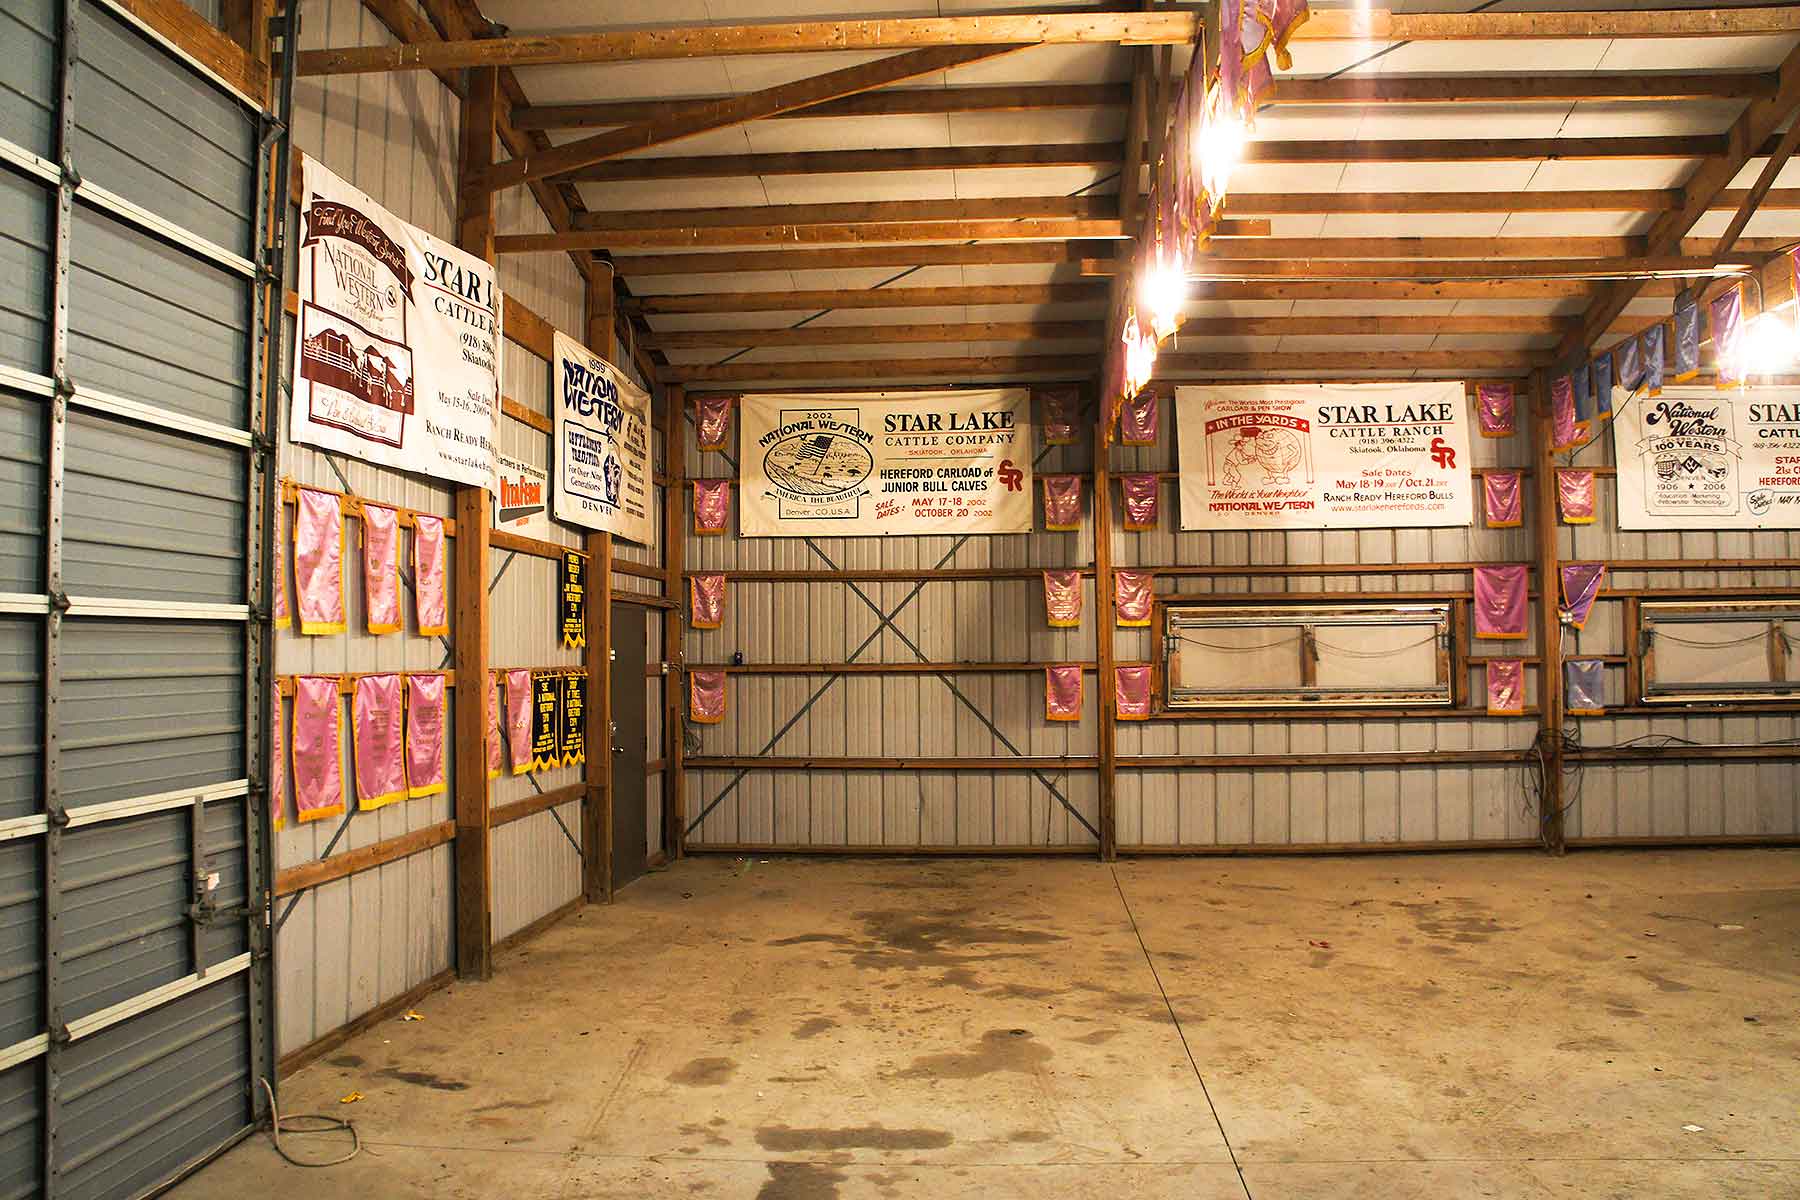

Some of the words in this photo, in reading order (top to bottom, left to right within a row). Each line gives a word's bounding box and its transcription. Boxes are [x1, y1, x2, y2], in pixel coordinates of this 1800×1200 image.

[322, 238, 378, 289] NATIONAL
[424, 251, 480, 303] STAR
[334, 269, 384, 312] WESTERN
[434, 296, 486, 331] CATTLE
[589, 358, 606, 374] 1999
[1318, 406, 1380, 424] STAR
[1385, 403, 1454, 422] LAKE
[1646, 402, 1720, 426] National
[884, 413, 943, 432] STAR
[948, 411, 1016, 431] LAKE
[1216, 419, 1230, 430] IN
[1230, 416, 1254, 426] THE
[1255, 415, 1298, 428] YARDS
[1670, 418, 1728, 436] Western
[758, 420, 815, 448] NATIONAL
[818, 420, 874, 444] WESTERN
[1330, 428, 1386, 438] CATTLE
[1393, 426, 1443, 436] RANCH
[885, 436, 938, 446] CATTLE
[946, 434, 1016, 446] COMPANY
[1655, 442, 1674, 451] 100
[1676, 440, 1720, 452] YEARS
[880, 468, 933, 480] HEREFORD
[936, 467, 982, 478] CARLOAD
[984, 467, 994, 478] of
[1775, 466, 1791, 474] 21st
[570, 476, 601, 492] Generations
[881, 481, 918, 493] JUNIOR
[922, 480, 948, 492] BULL
[951, 480, 988, 492] CALVES
[1336, 480, 1359, 490] May
[1703, 482, 1726, 490] 2006
[912, 498, 934, 506] MAY
[938, 497, 962, 506] 17-18
[1324, 492, 1352, 502] RANCH
[1354, 492, 1382, 502] READY
[1384, 492, 1428, 500] HEREFORD
[1429, 490, 1454, 500] BULLS
[874, 498, 895, 512] SALE
[1208, 502, 1260, 512] NATIONAL
[1262, 500, 1314, 510] WESTERN
[914, 508, 953, 518] OCTOBER
[956, 508, 968, 517] 20
